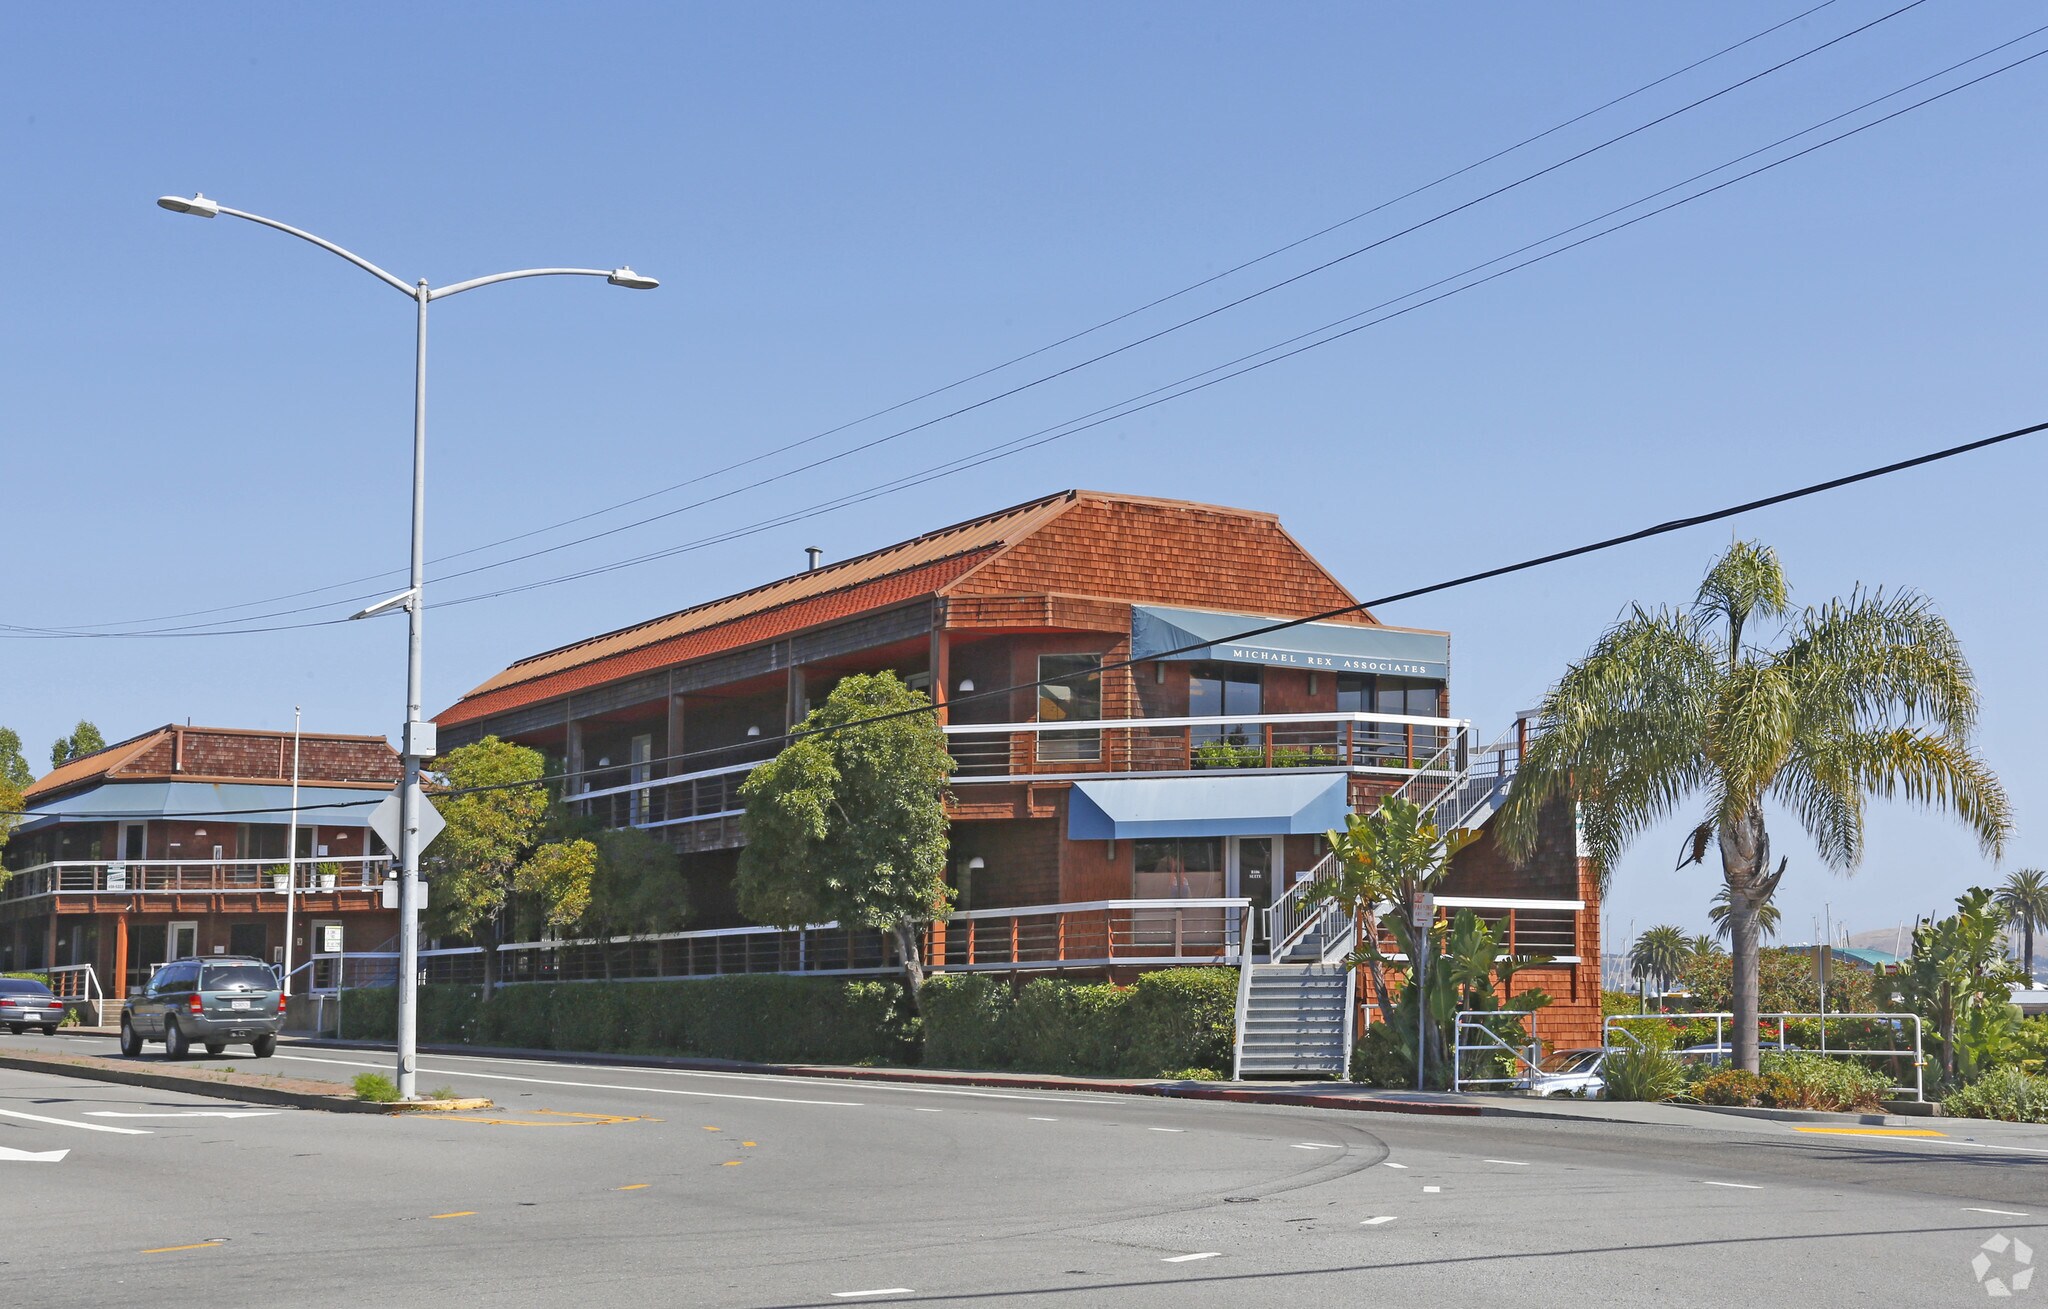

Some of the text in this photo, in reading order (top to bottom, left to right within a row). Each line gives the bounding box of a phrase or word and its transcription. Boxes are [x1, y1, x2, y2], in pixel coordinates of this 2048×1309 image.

[1233, 649, 1426, 674] MICHAEL REX ASSOCIATES
